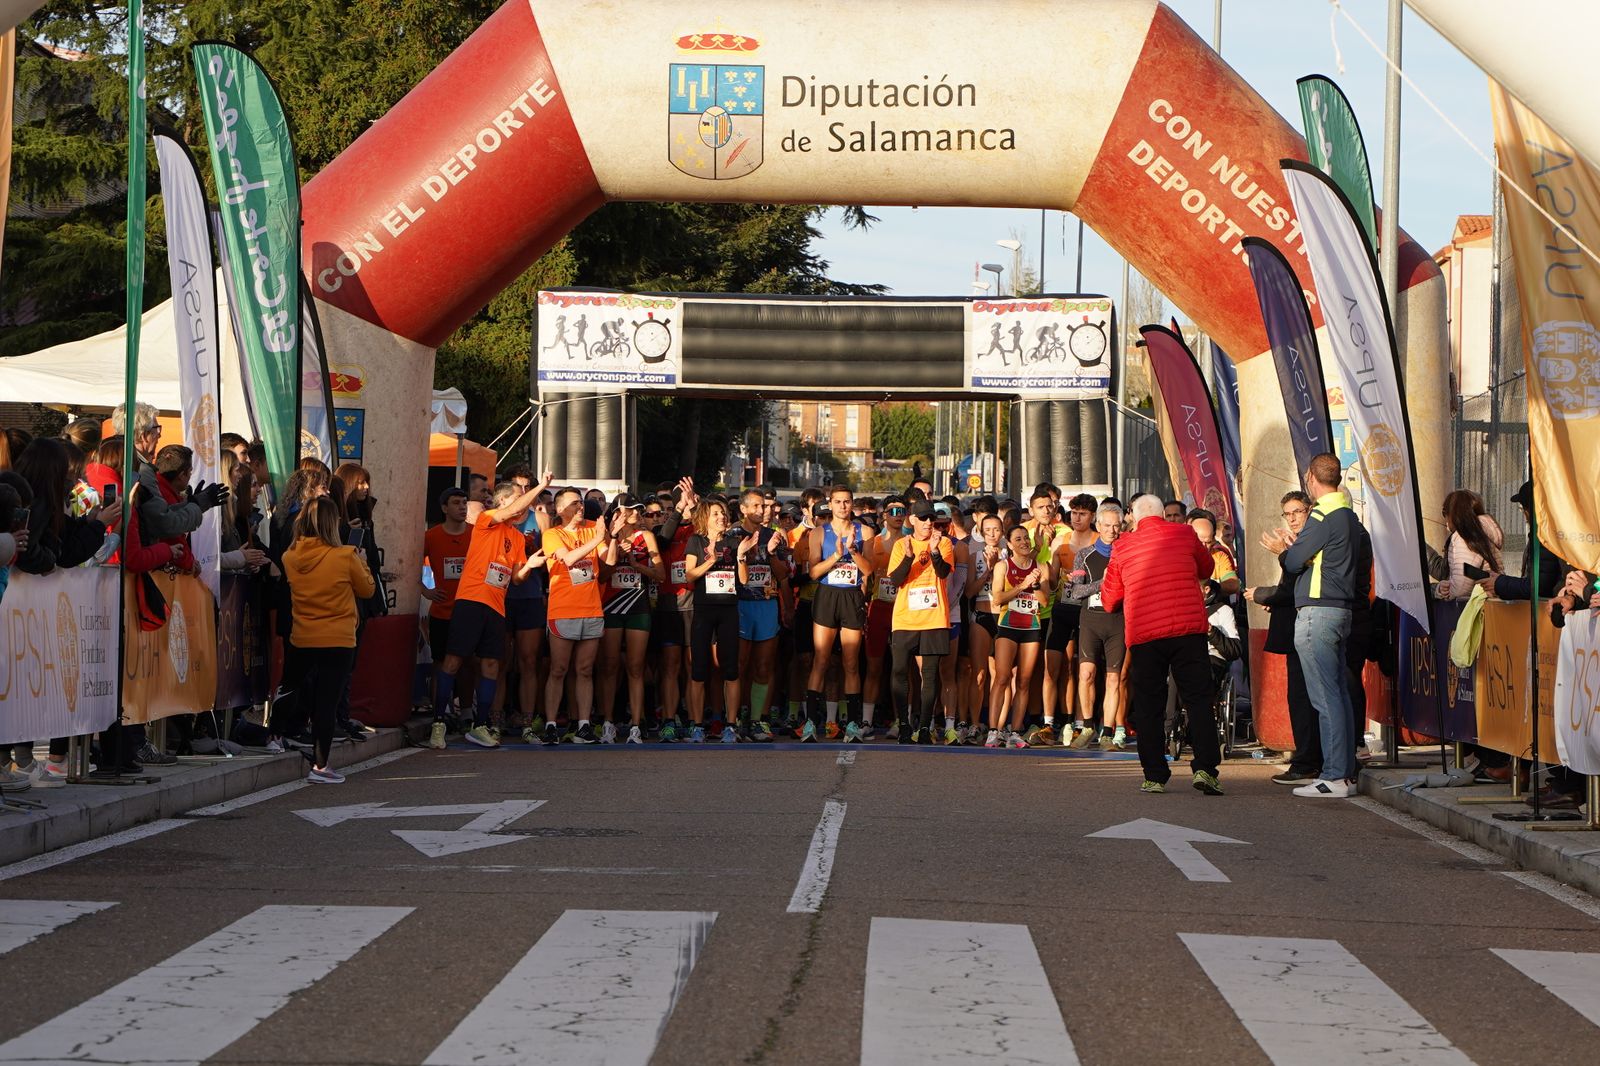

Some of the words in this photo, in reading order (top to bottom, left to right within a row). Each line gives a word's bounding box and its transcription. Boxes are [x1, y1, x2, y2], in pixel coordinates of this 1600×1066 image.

[781, 74, 977, 116] Diputación
[781, 129, 812, 152] de
[828, 121, 1016, 152] Salamanca
[1148, 98, 1213, 161] CON
[1208, 154, 1308, 257] NUEST
[317, 231, 384, 293] CON
[380, 201, 426, 238] EL
[420, 77, 557, 203] DEPORTE
[546, 371, 666, 384] www.orycronsport.com
[981, 377, 1101, 389] www.orycronsport.com
[498, 573, 504, 582] 5
[581, 568, 588, 577] 3
[749, 573, 767, 582] 287
[835, 569, 853, 579] 293
[618, 574, 635, 583] 168
[718, 579, 725, 588] 8
[923, 595, 930, 604] 6
[1015, 599, 1033, 609] 158
